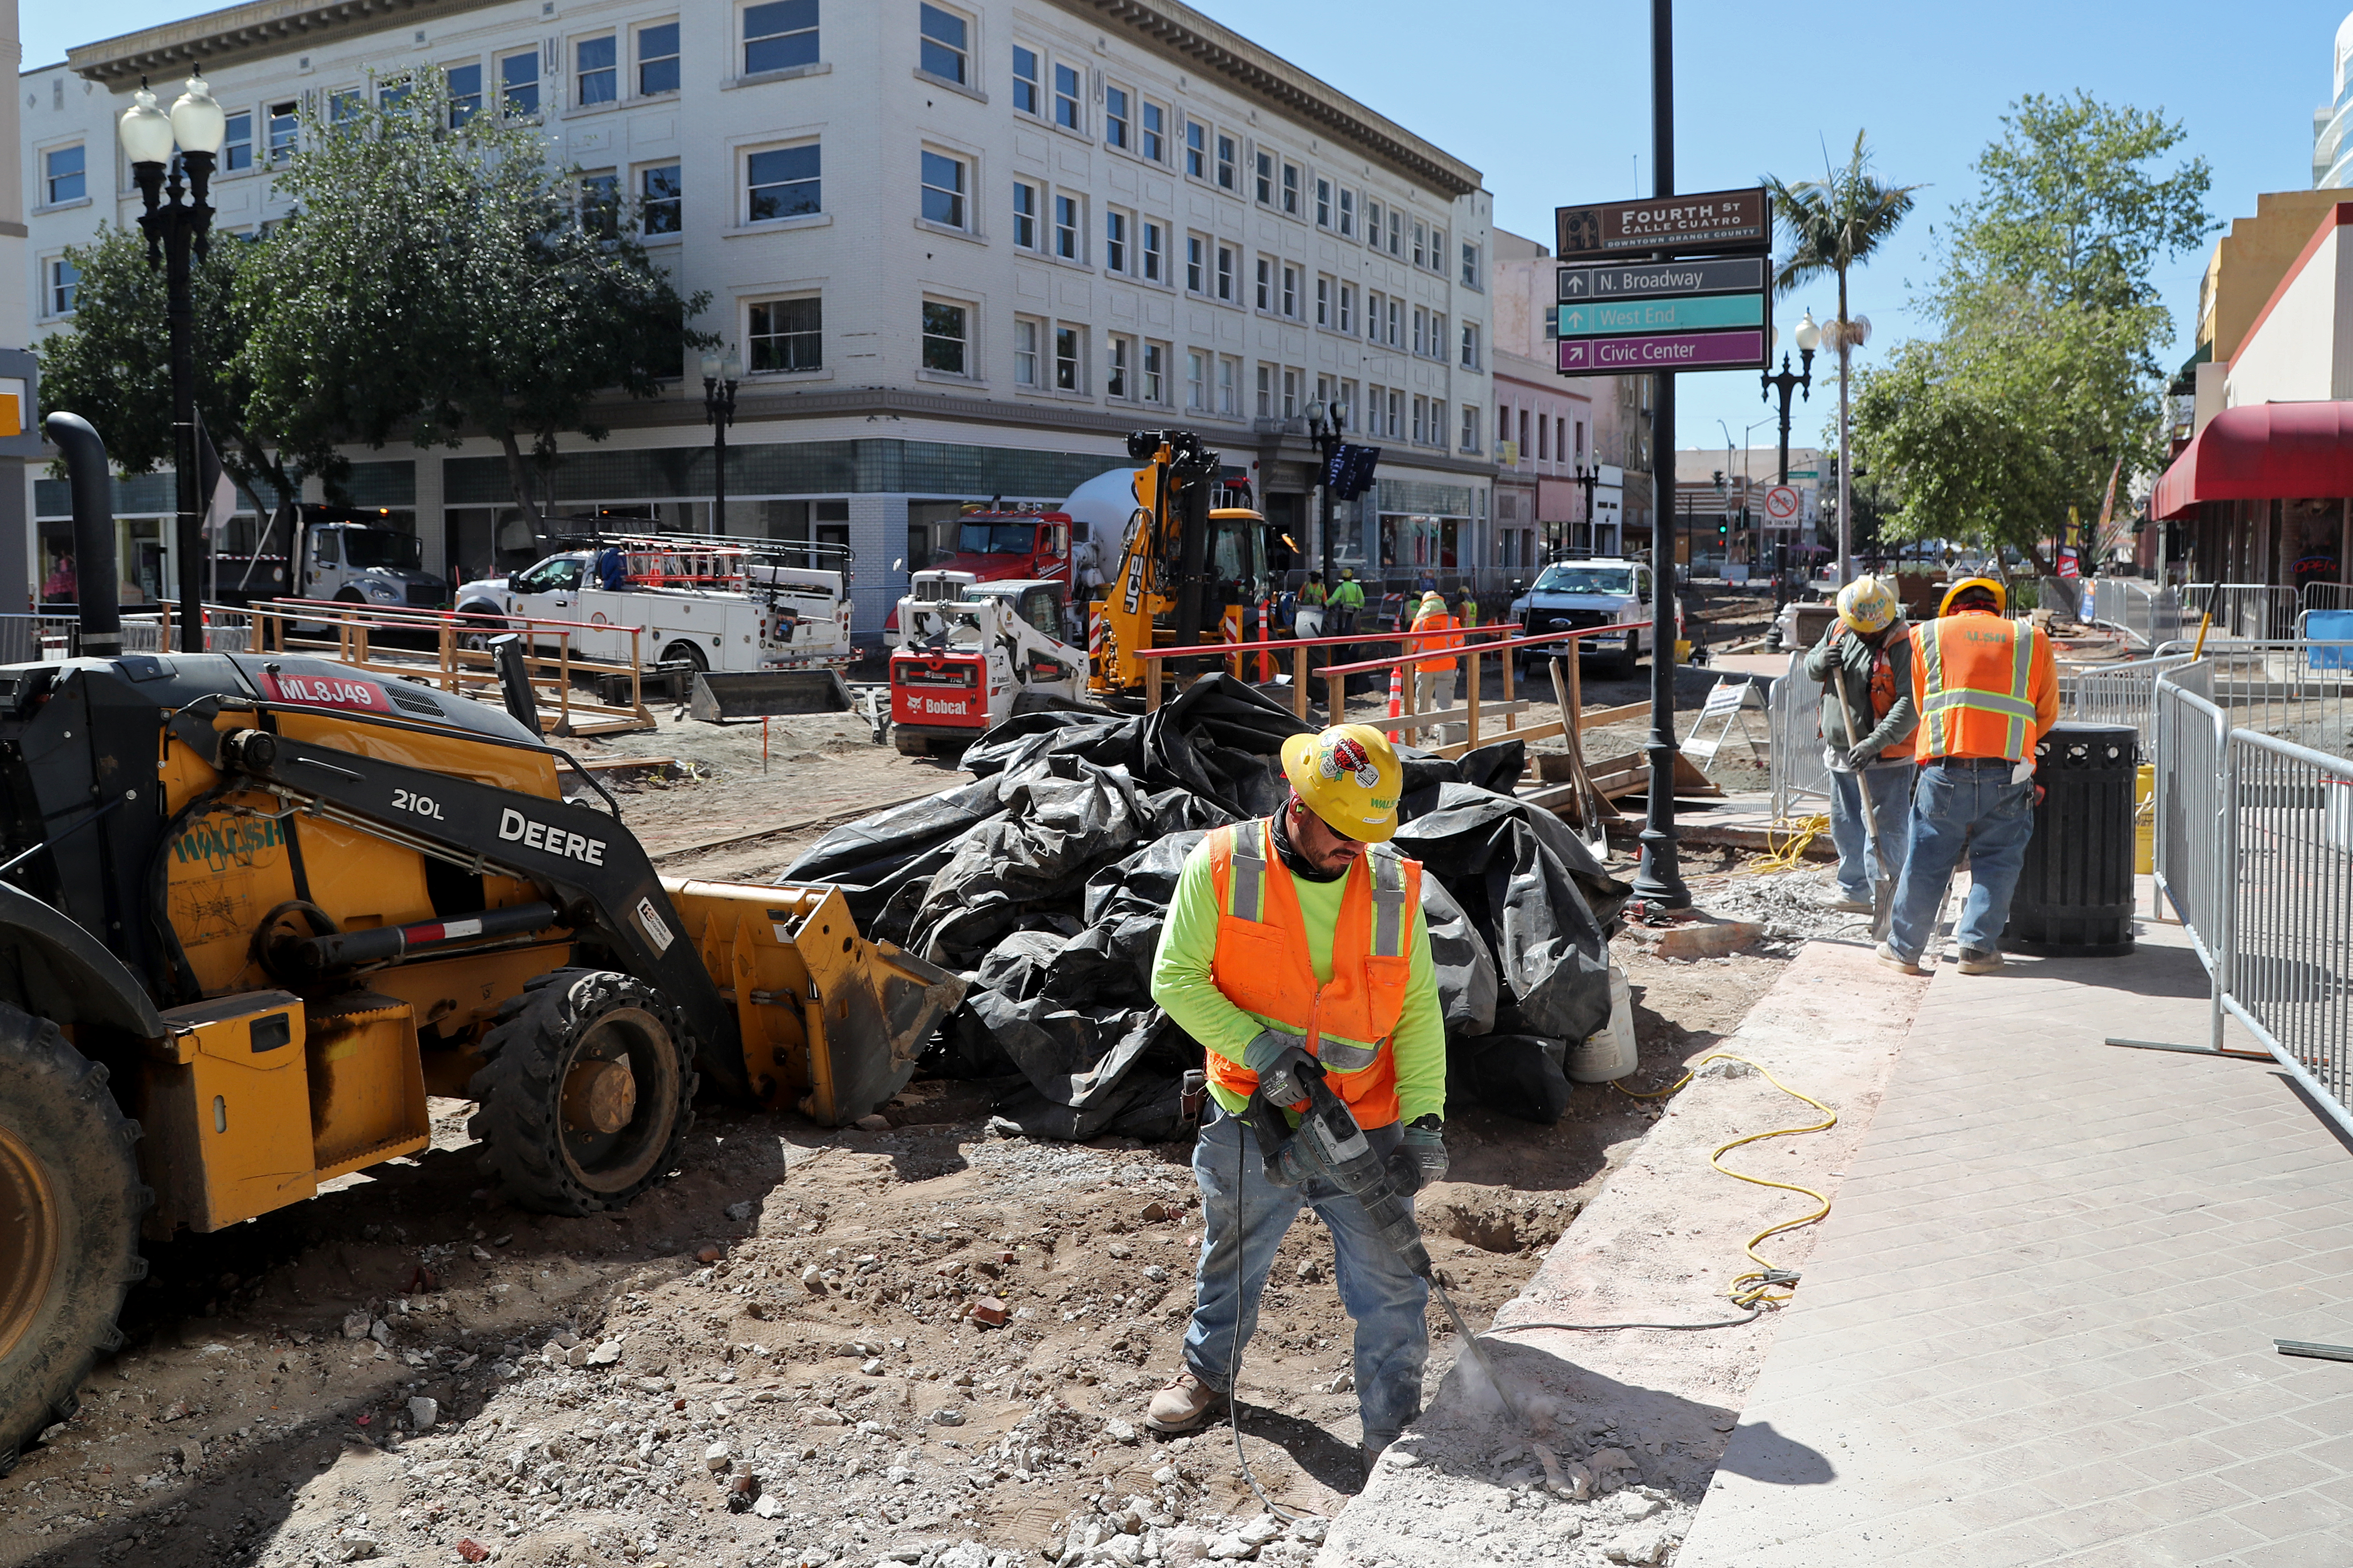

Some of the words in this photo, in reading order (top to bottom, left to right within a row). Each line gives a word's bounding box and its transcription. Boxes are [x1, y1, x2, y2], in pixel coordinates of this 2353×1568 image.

[1622, 205, 1712, 225] FOURTH
[1723, 203, 1740, 212] ST
[1622, 222, 1671, 234] CALLE
[1678, 216, 1740, 229] CUATRO
[1607, 236, 1664, 247] DOWNTOWN
[1669, 232, 1709, 242] ORANGE
[1714, 229, 1755, 238] COUNTY
[1600, 274, 1616, 290] N.
[1623, 269, 1703, 289] Broadway
[1600, 310, 1640, 325] West
[1646, 306, 1675, 323] End
[1600, 345, 1638, 362] Civic
[1642, 342, 1696, 359] Center
[1125, 555, 1144, 613] JCB
[277, 679, 372, 705] ML8J49
[926, 699, 967, 715] Bobcat
[1337, 751, 1351, 765] 652
[1338, 740, 1364, 770] LABORERS
[391, 789, 445, 821] 210L
[498, 808, 607, 866] DEERE
[651, 920, 668, 943] EQUIPMENT
